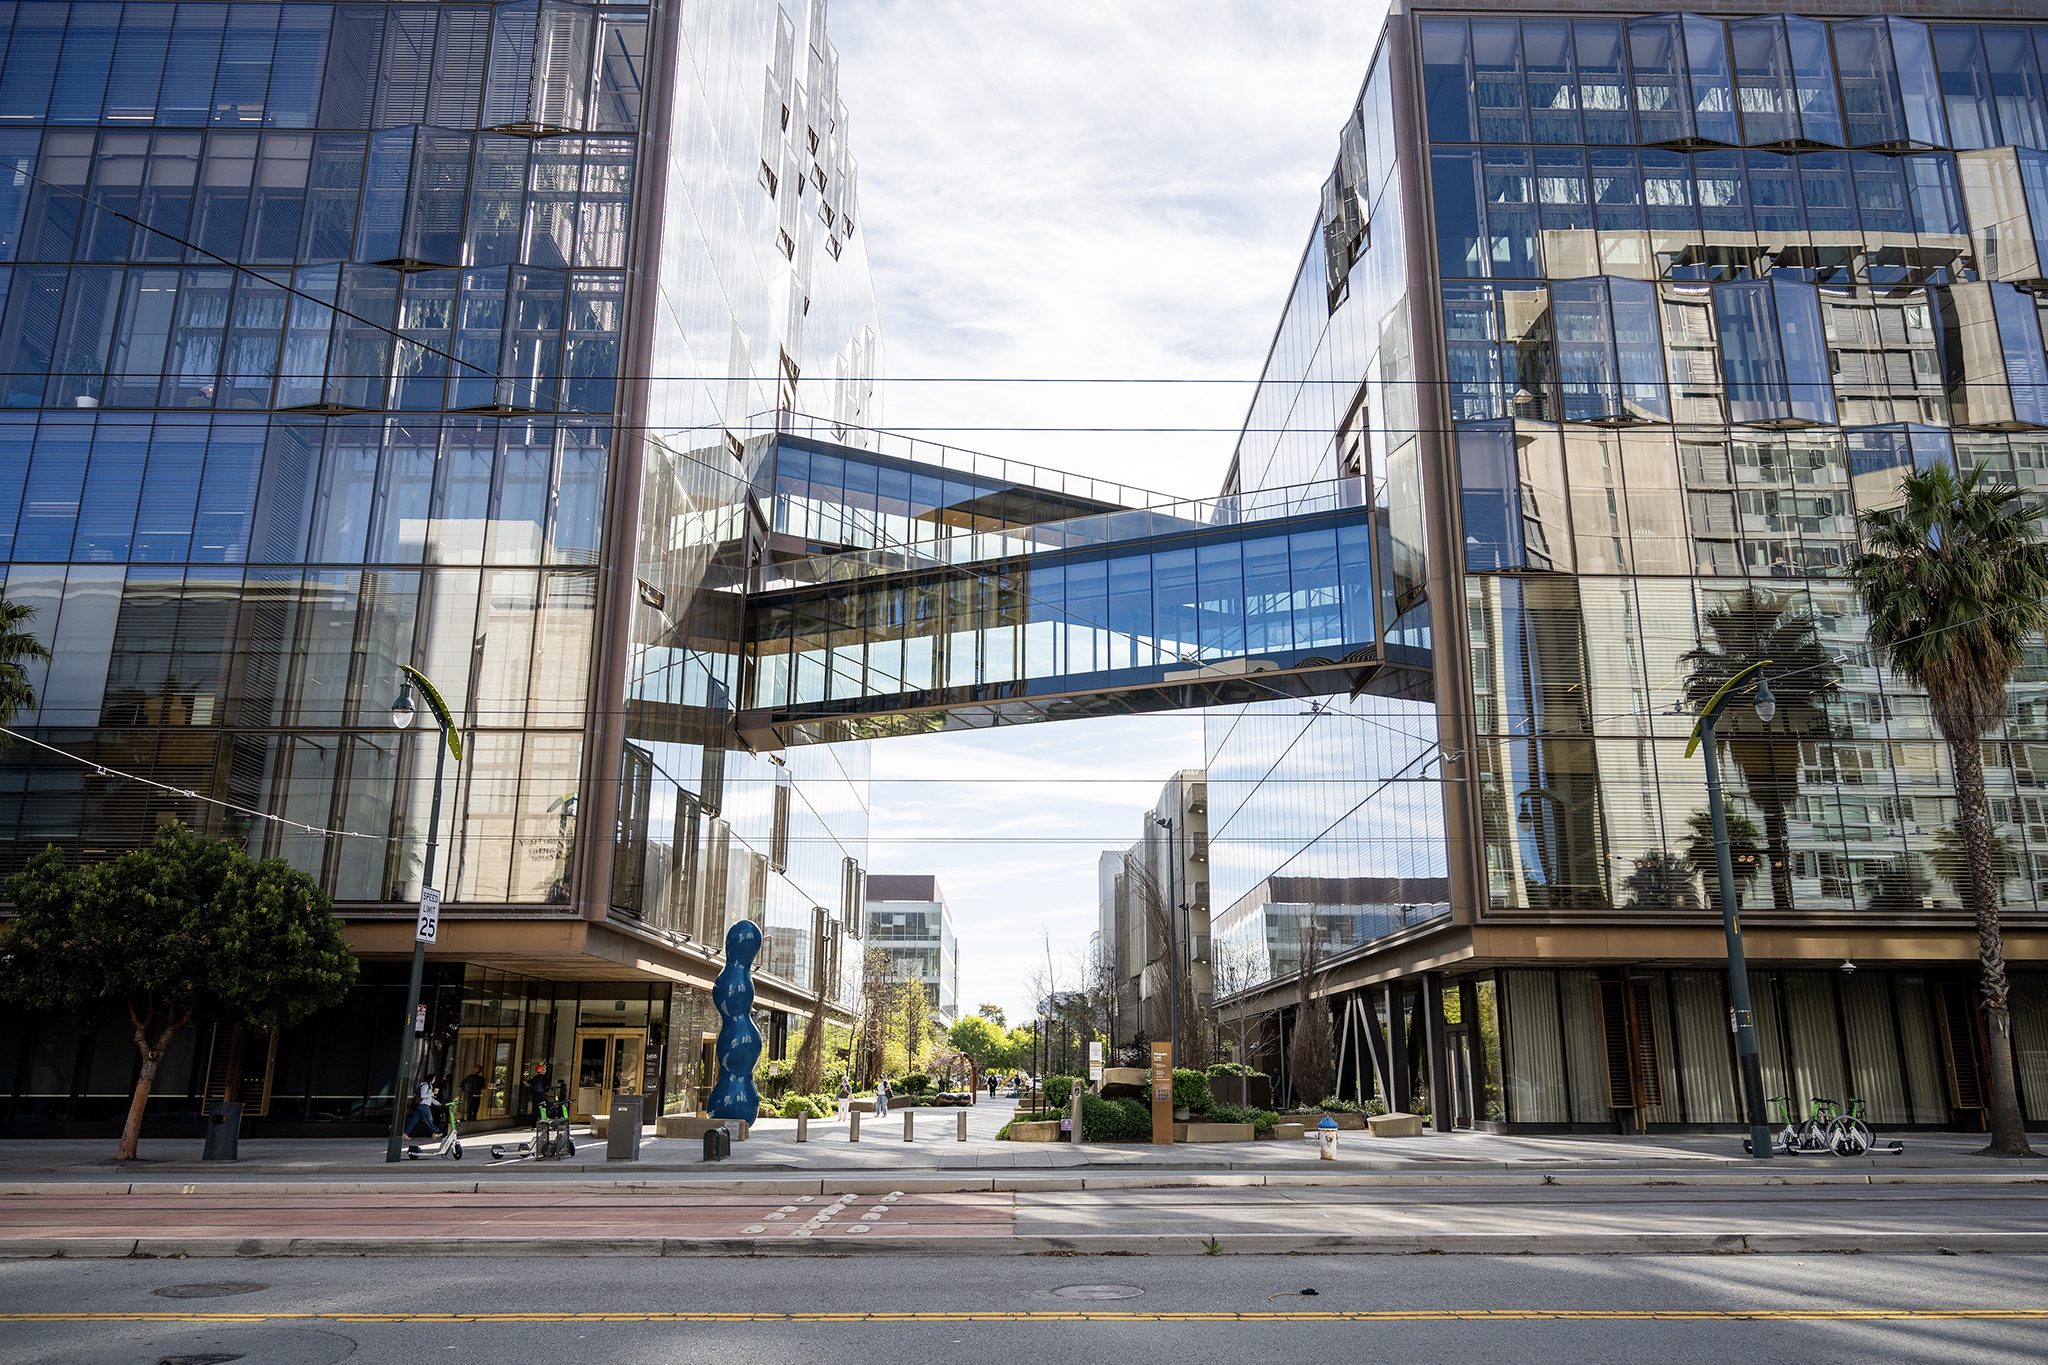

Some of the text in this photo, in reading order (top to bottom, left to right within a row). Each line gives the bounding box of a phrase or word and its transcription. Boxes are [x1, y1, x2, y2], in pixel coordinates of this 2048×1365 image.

[423, 892, 439, 904] SPEED
[423, 905, 436, 915] LIMIT
[420, 917, 436, 937] 25
